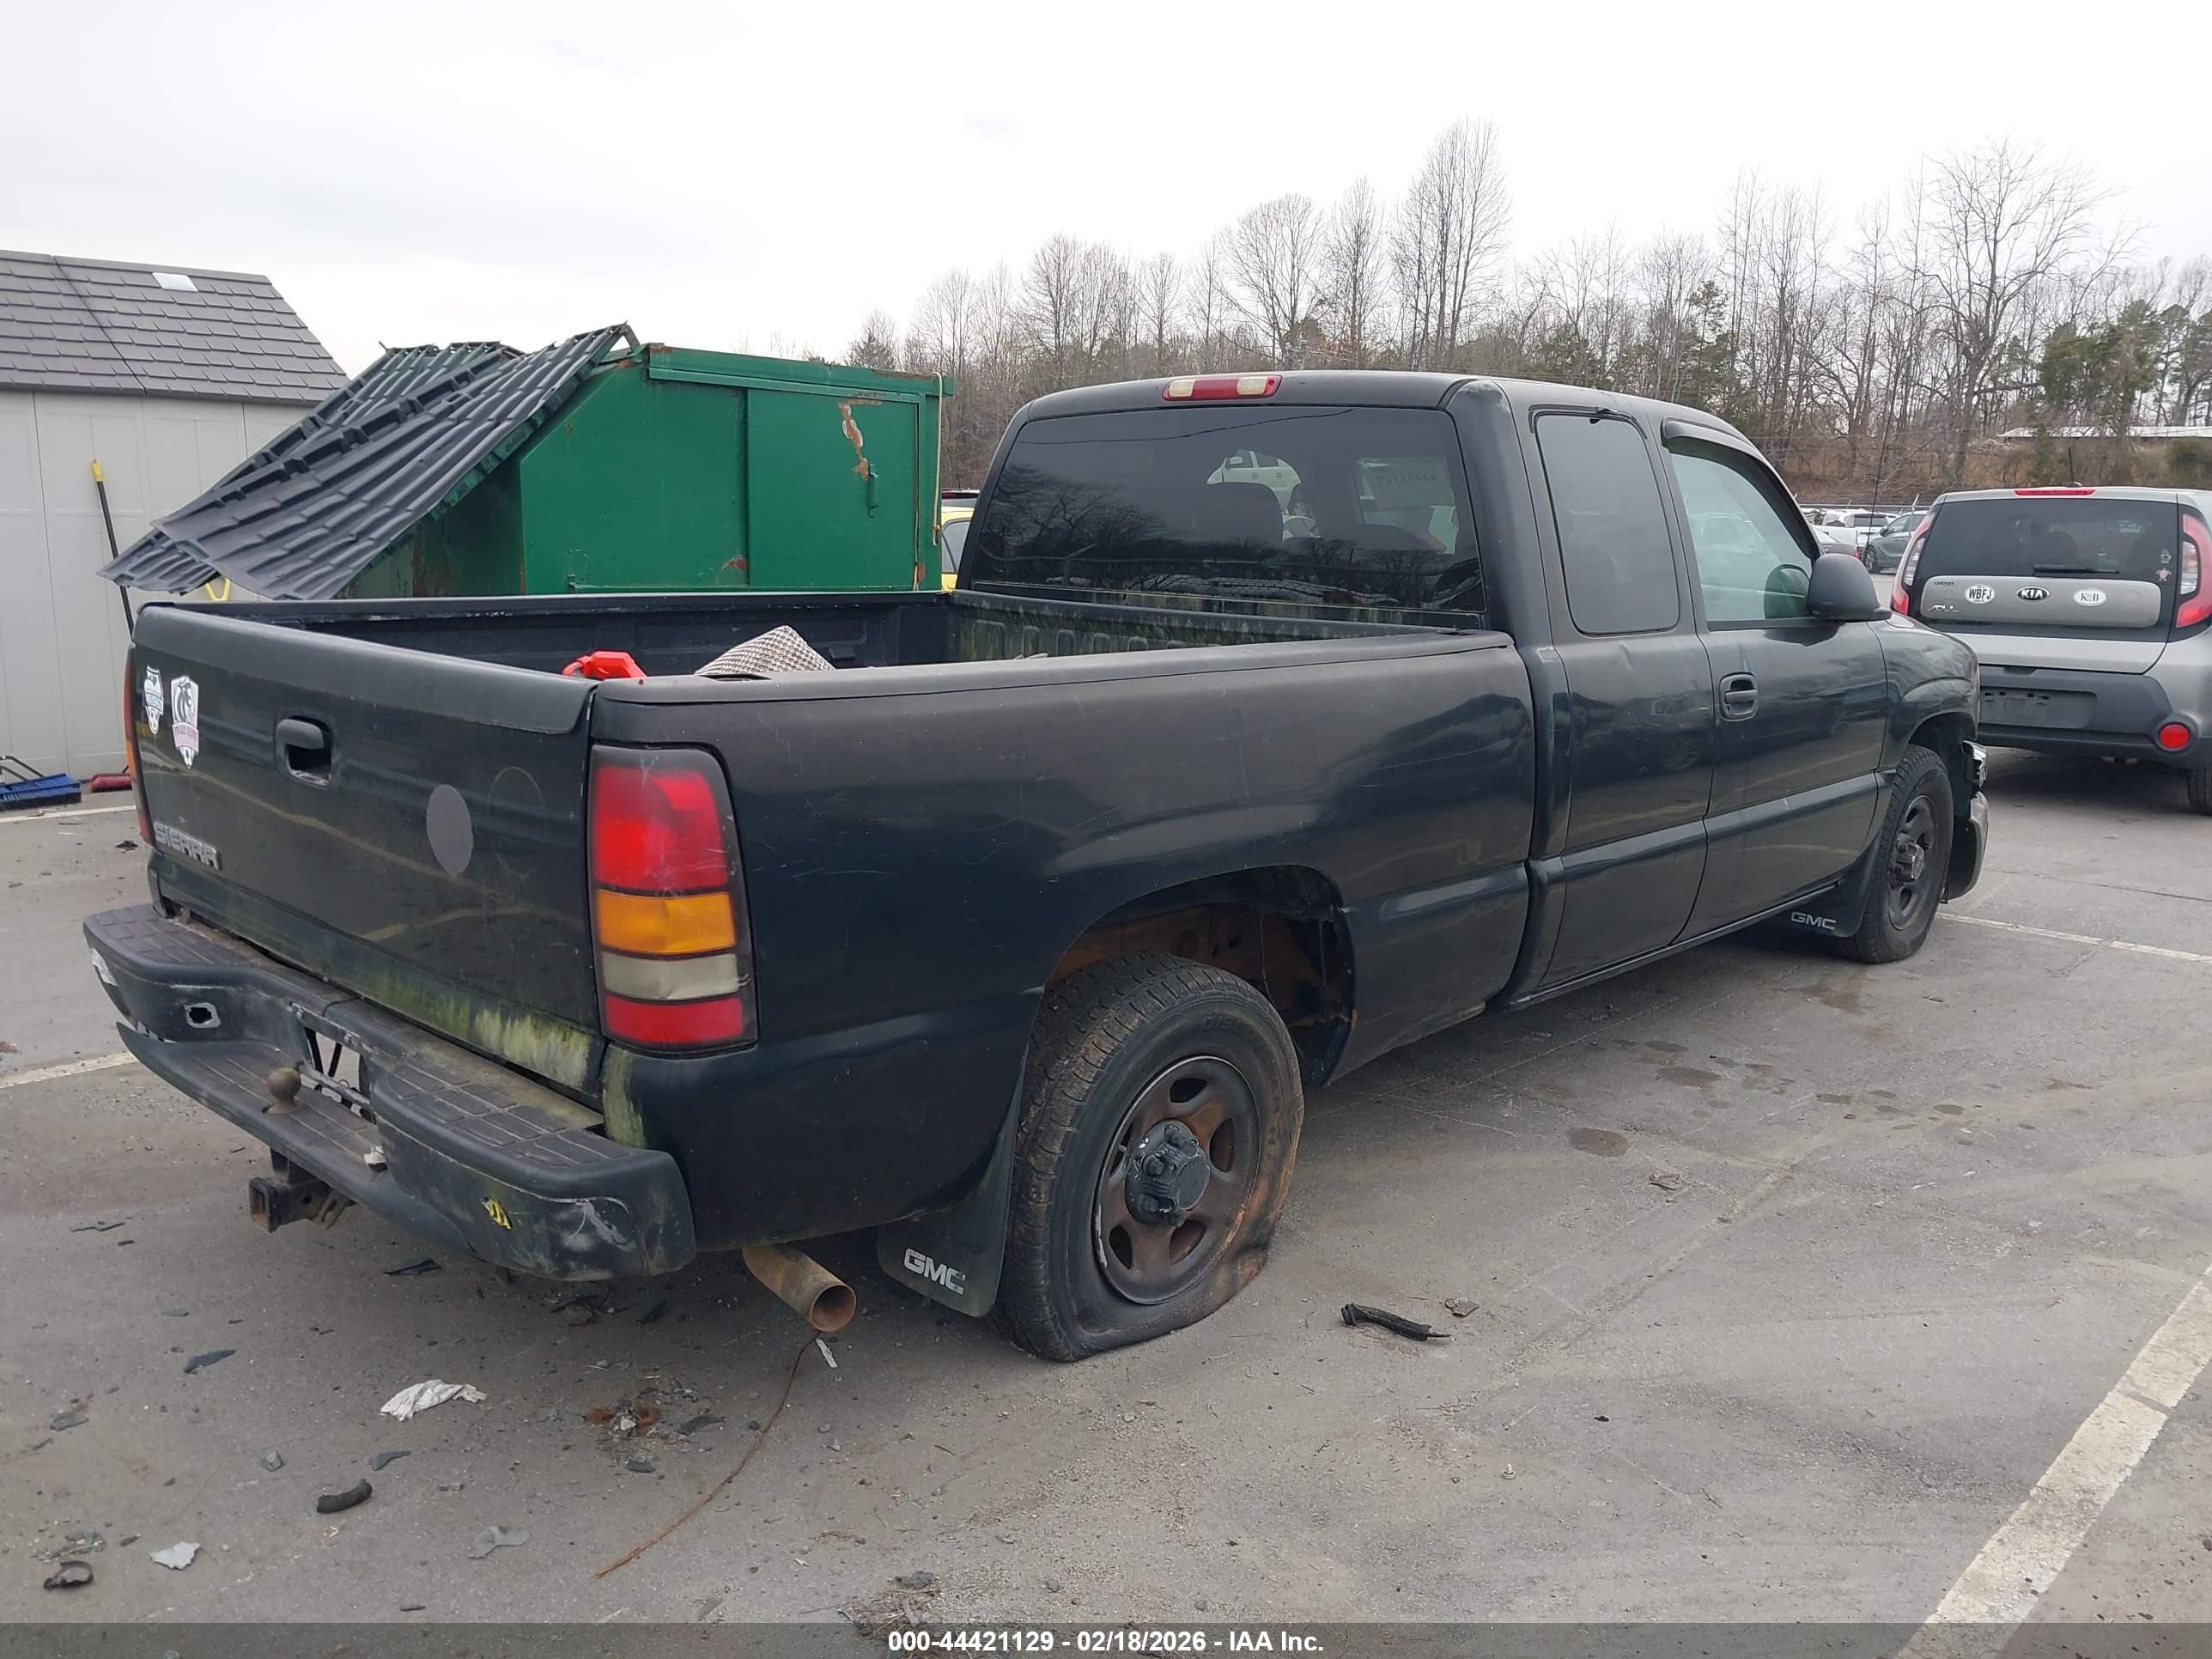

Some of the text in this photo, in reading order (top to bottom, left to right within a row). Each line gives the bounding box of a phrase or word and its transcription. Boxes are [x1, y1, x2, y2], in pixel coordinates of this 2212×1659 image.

[1968, 588, 1992, 600] WBFJ
[2021, 589, 2044, 599] KIA
[154, 822, 219, 870] SIERRA
[1791, 912, 1837, 931] GMC
[904, 1248, 966, 1295] GMC
